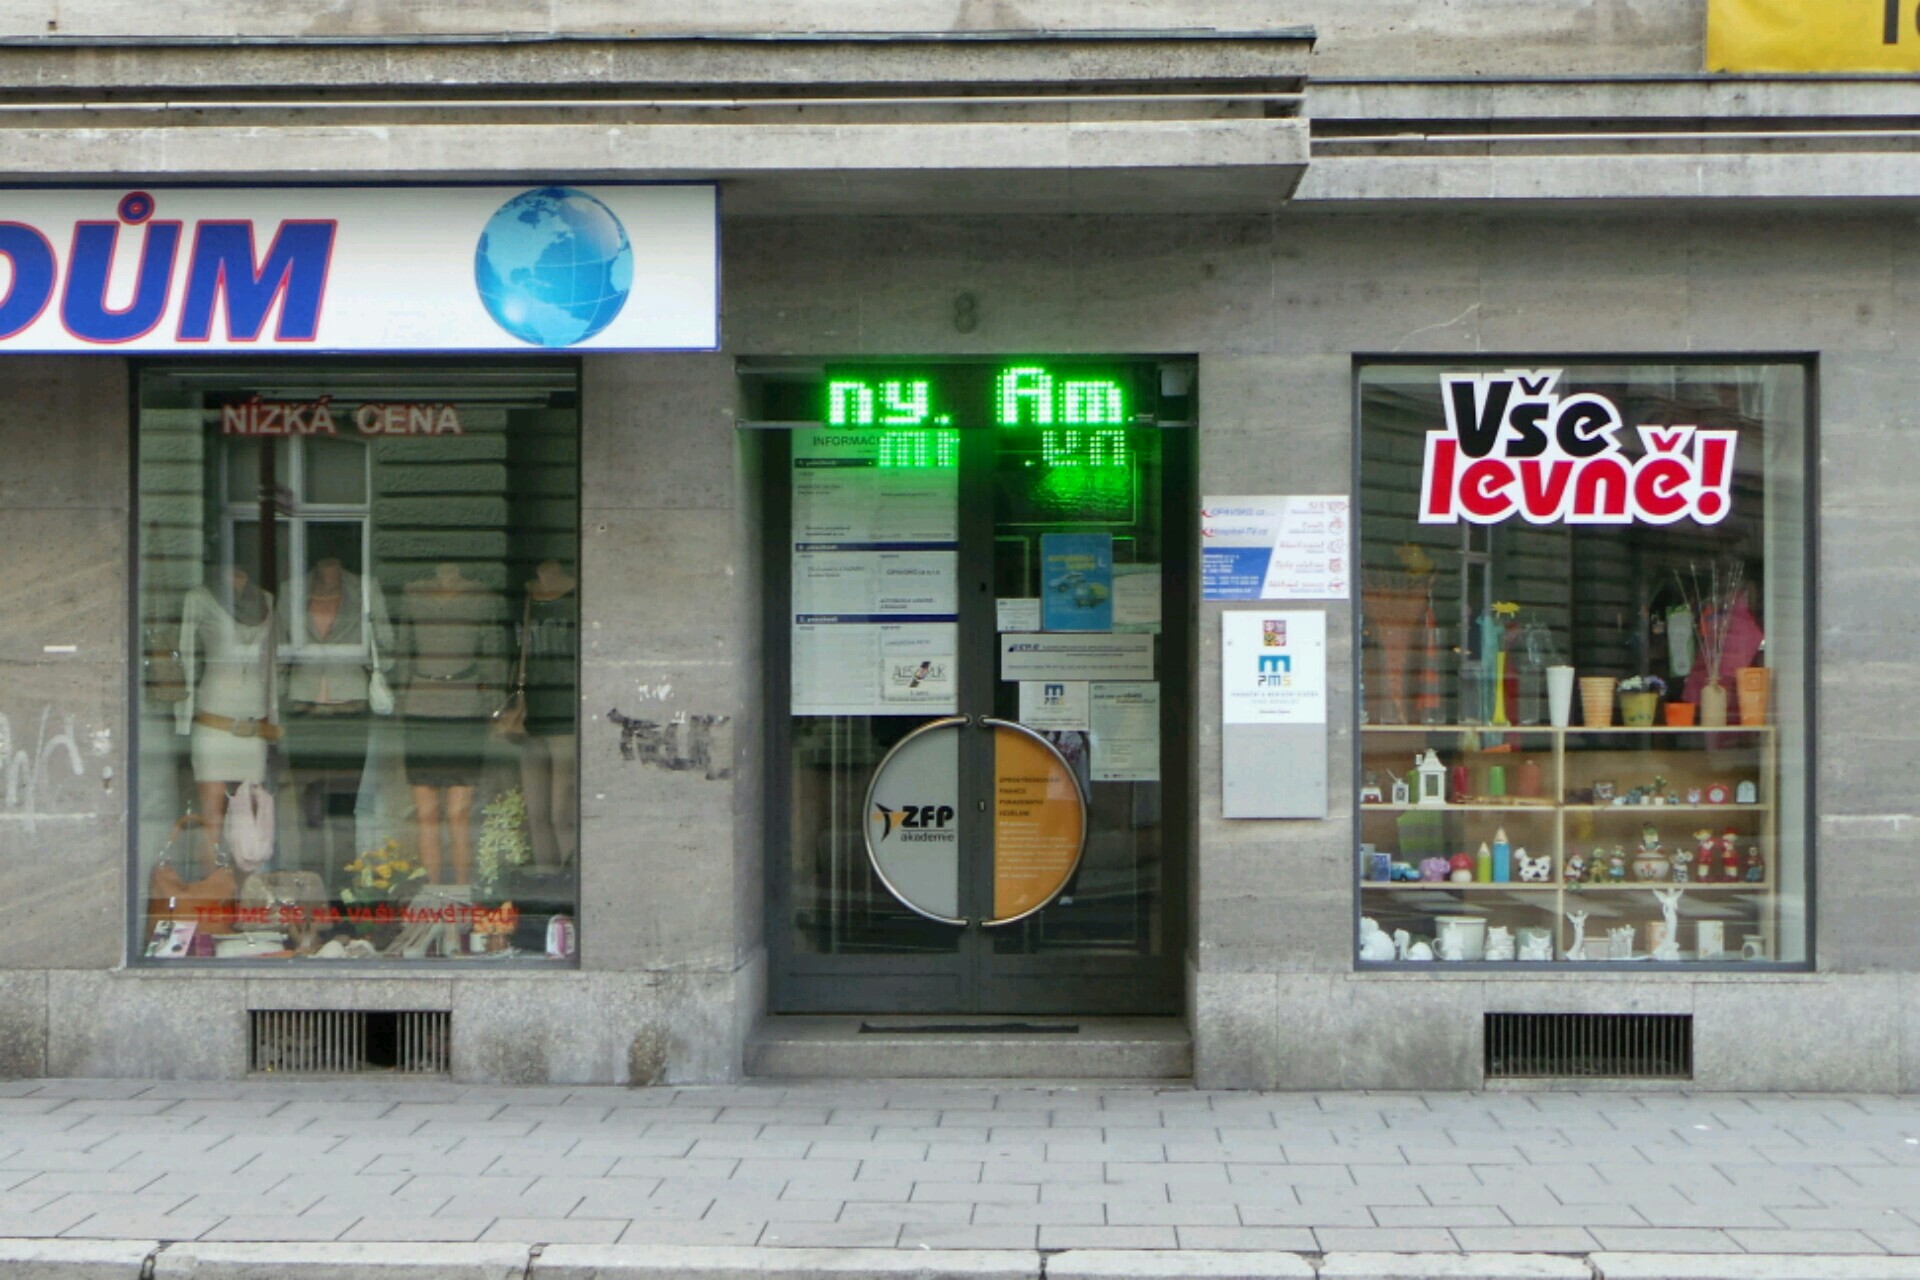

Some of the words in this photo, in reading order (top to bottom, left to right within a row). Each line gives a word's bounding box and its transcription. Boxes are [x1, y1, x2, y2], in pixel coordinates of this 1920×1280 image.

[954, 292, 978, 334] 8
[222, 395, 337, 435] NÍZKÁ
[356, 404, 463, 435] CENA
[1446, 372, 1617, 460] Vše
[1424, 428, 1731, 519] levně!
[901, 805, 955, 828] ZFP
[901, 832, 955, 842] akademie
